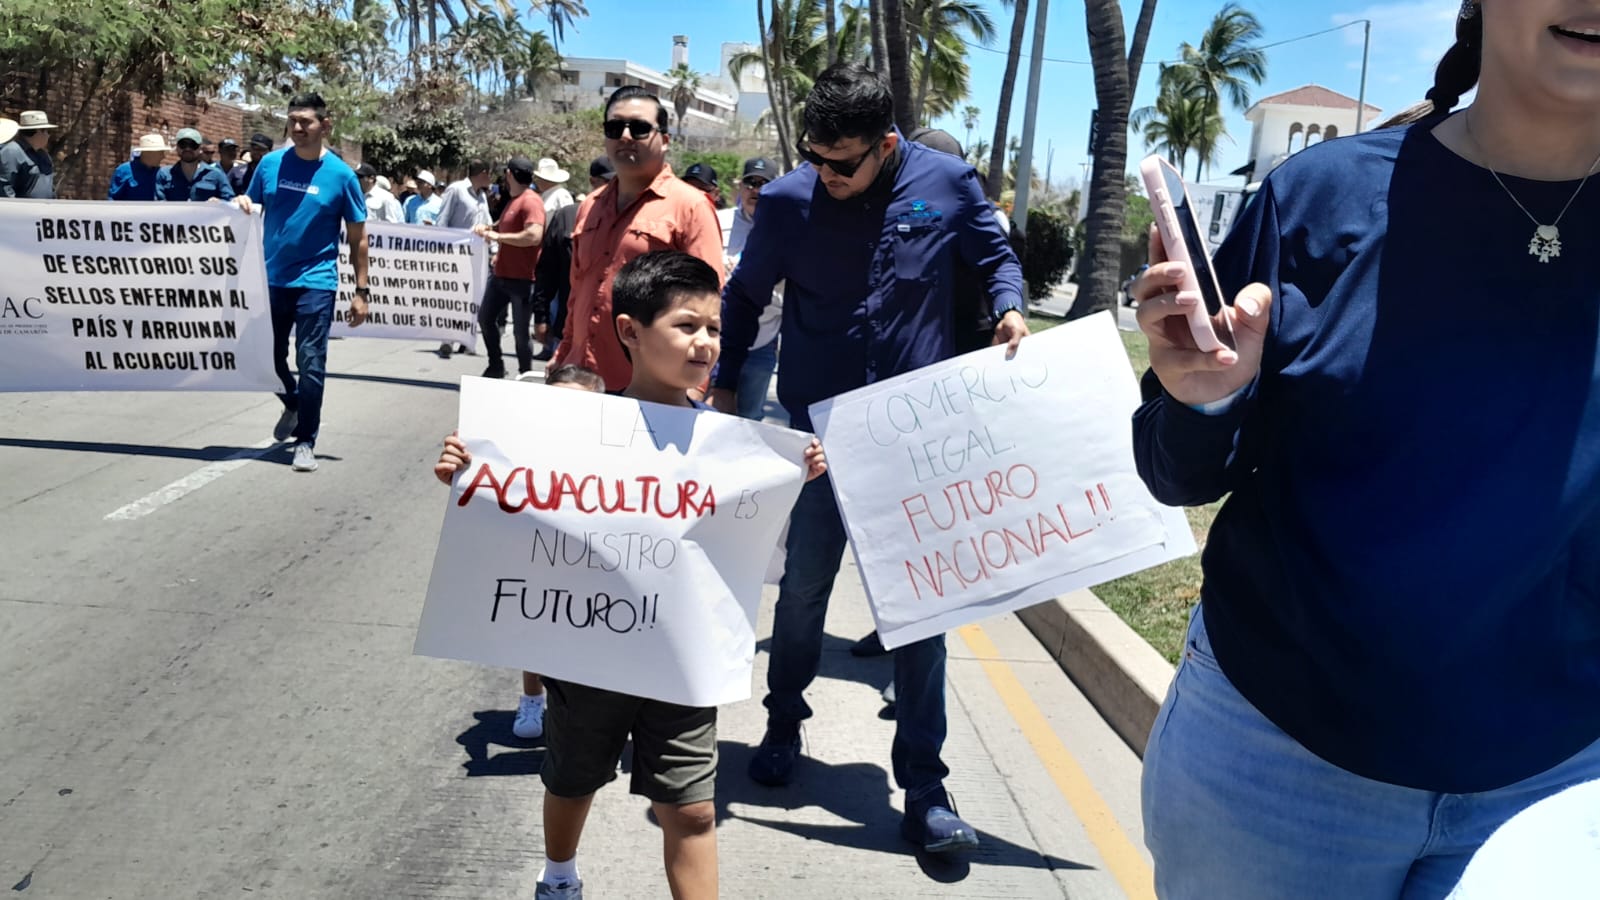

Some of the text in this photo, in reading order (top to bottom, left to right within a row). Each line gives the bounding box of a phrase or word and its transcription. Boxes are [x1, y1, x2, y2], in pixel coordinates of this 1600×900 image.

[36, 218, 236, 244] ¡BASTA DE SENASICA
[388, 236, 454, 255] TRAICIONA
[459, 244, 474, 256] AL
[43, 254, 239, 276] DE ESCRITORIO! SUS
[394, 258, 459, 273] CERTIFICA
[44, 286, 250, 310] SELLOS ENFERMAN AL
[383, 277, 459, 292] IMPORTADO
[463, 282, 470, 294] Y
[394, 296, 409, 307] AL
[72, 315, 237, 340] PAÍS Y ARRUINAN
[392, 313, 417, 327] QUE
[85, 351, 237, 371] AL ACUACULTOR
[866, 360, 1049, 447] COMERCIO
[600, 399, 659, 450] LA
[457, 463, 761, 520] ACUACULTURA ES
[901, 463, 1038, 543] FUTURO
[531, 528, 677, 573] NUESTRO
[905, 482, 1117, 600] NACIONAL!!
[491, 579, 659, 633] FUTURO!!
